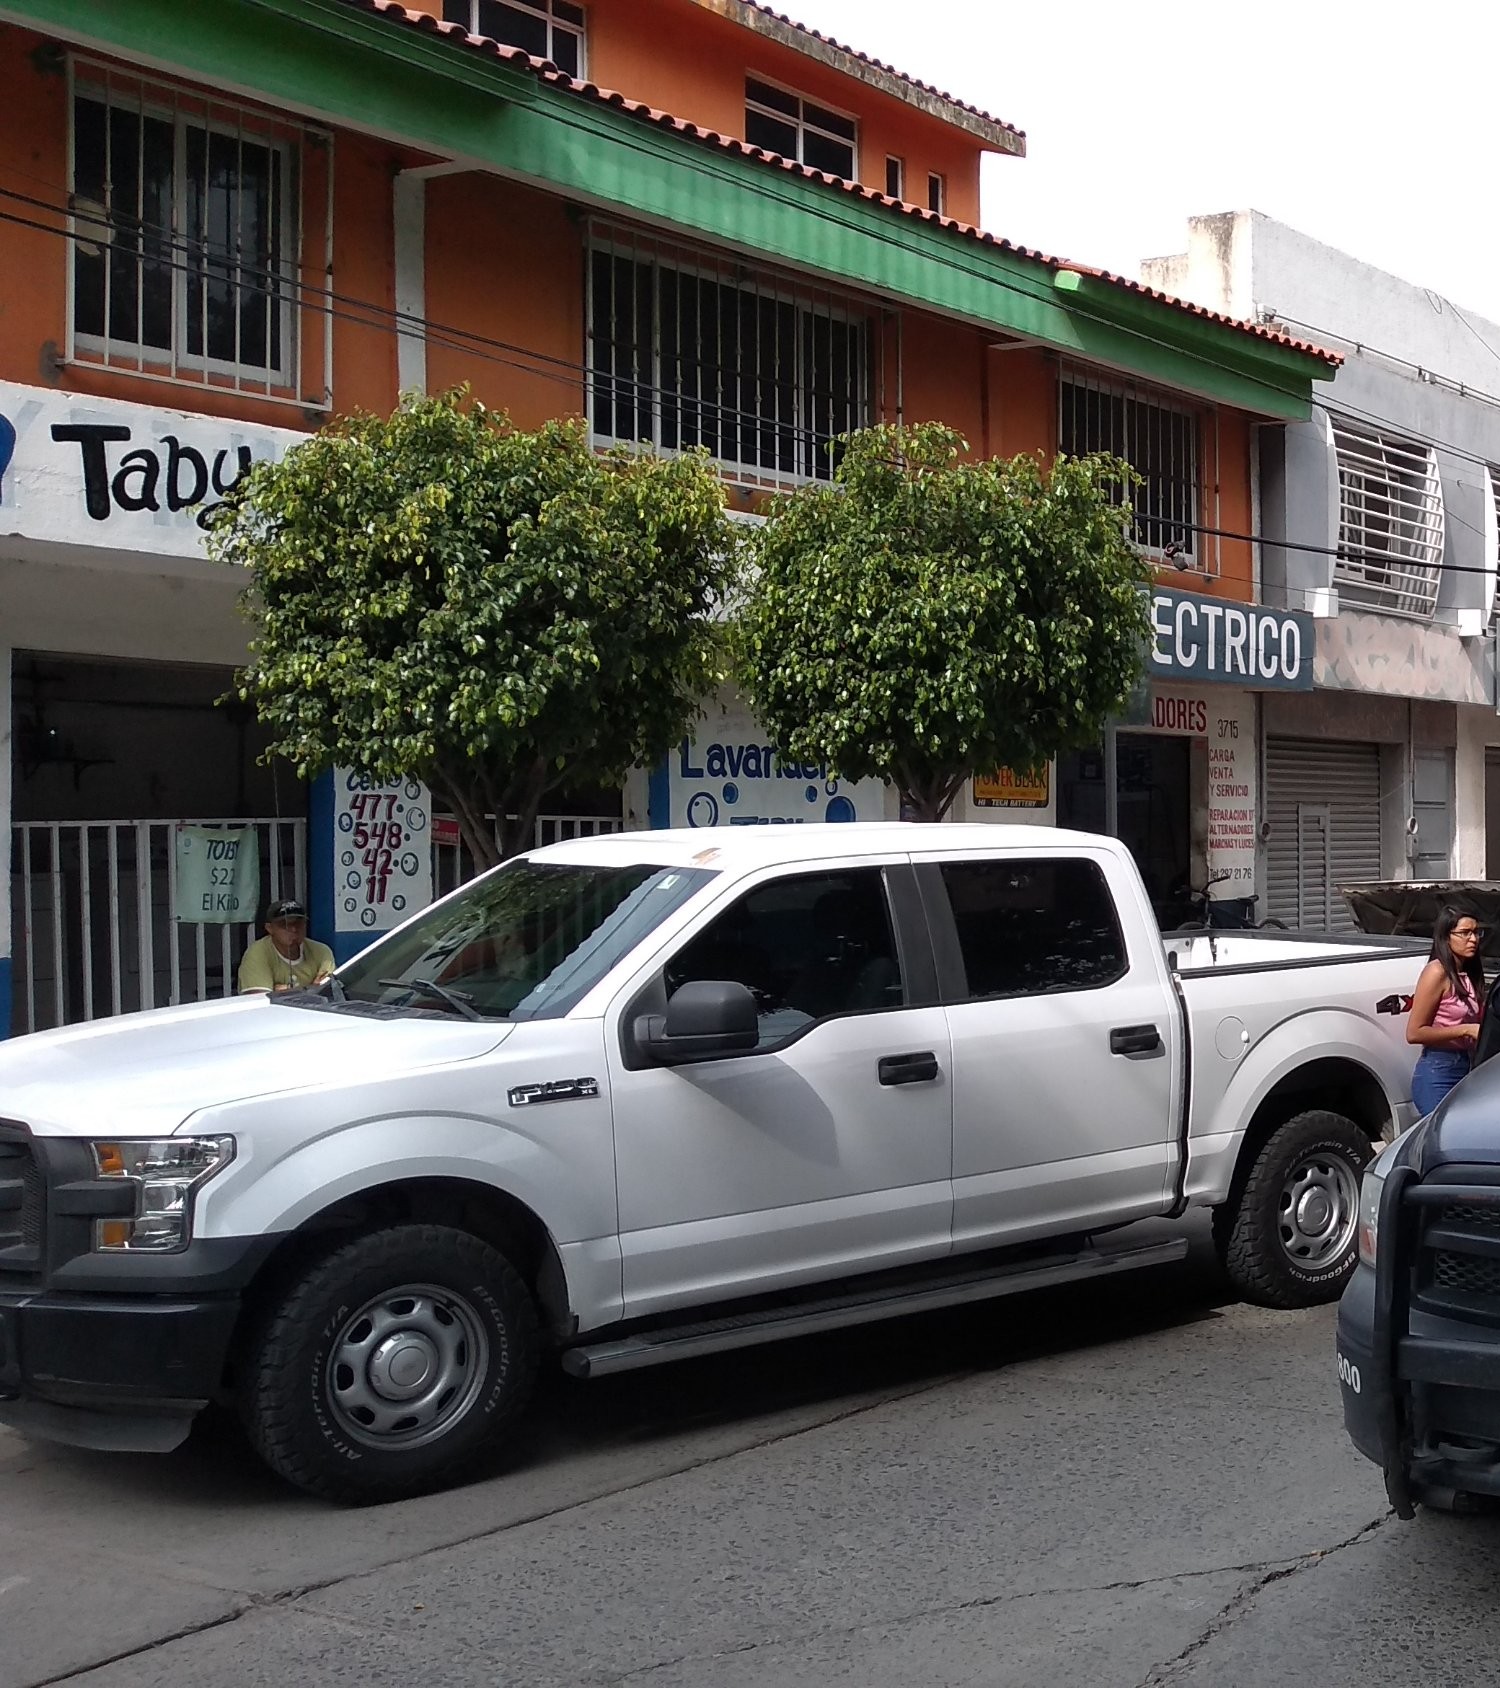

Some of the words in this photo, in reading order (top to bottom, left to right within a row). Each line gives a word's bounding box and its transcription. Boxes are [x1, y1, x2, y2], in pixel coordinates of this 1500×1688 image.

[1150, 596, 1301, 680] ECTRICO
[1150, 697, 1207, 732] DORES
[1217, 718, 1239, 739] 3715
[1209, 748, 1235, 762] CARGA
[1208, 766, 1234, 779] VENTA
[1209, 784, 1215, 797] Y
[1216, 784, 1249, 797] SERVICIO
[351, 793, 399, 821] 477
[352, 821, 403, 850] 548
[362, 848, 394, 876] 42
[366, 875, 388, 904] 11
[1337, 1352, 1361, 1394] 800
